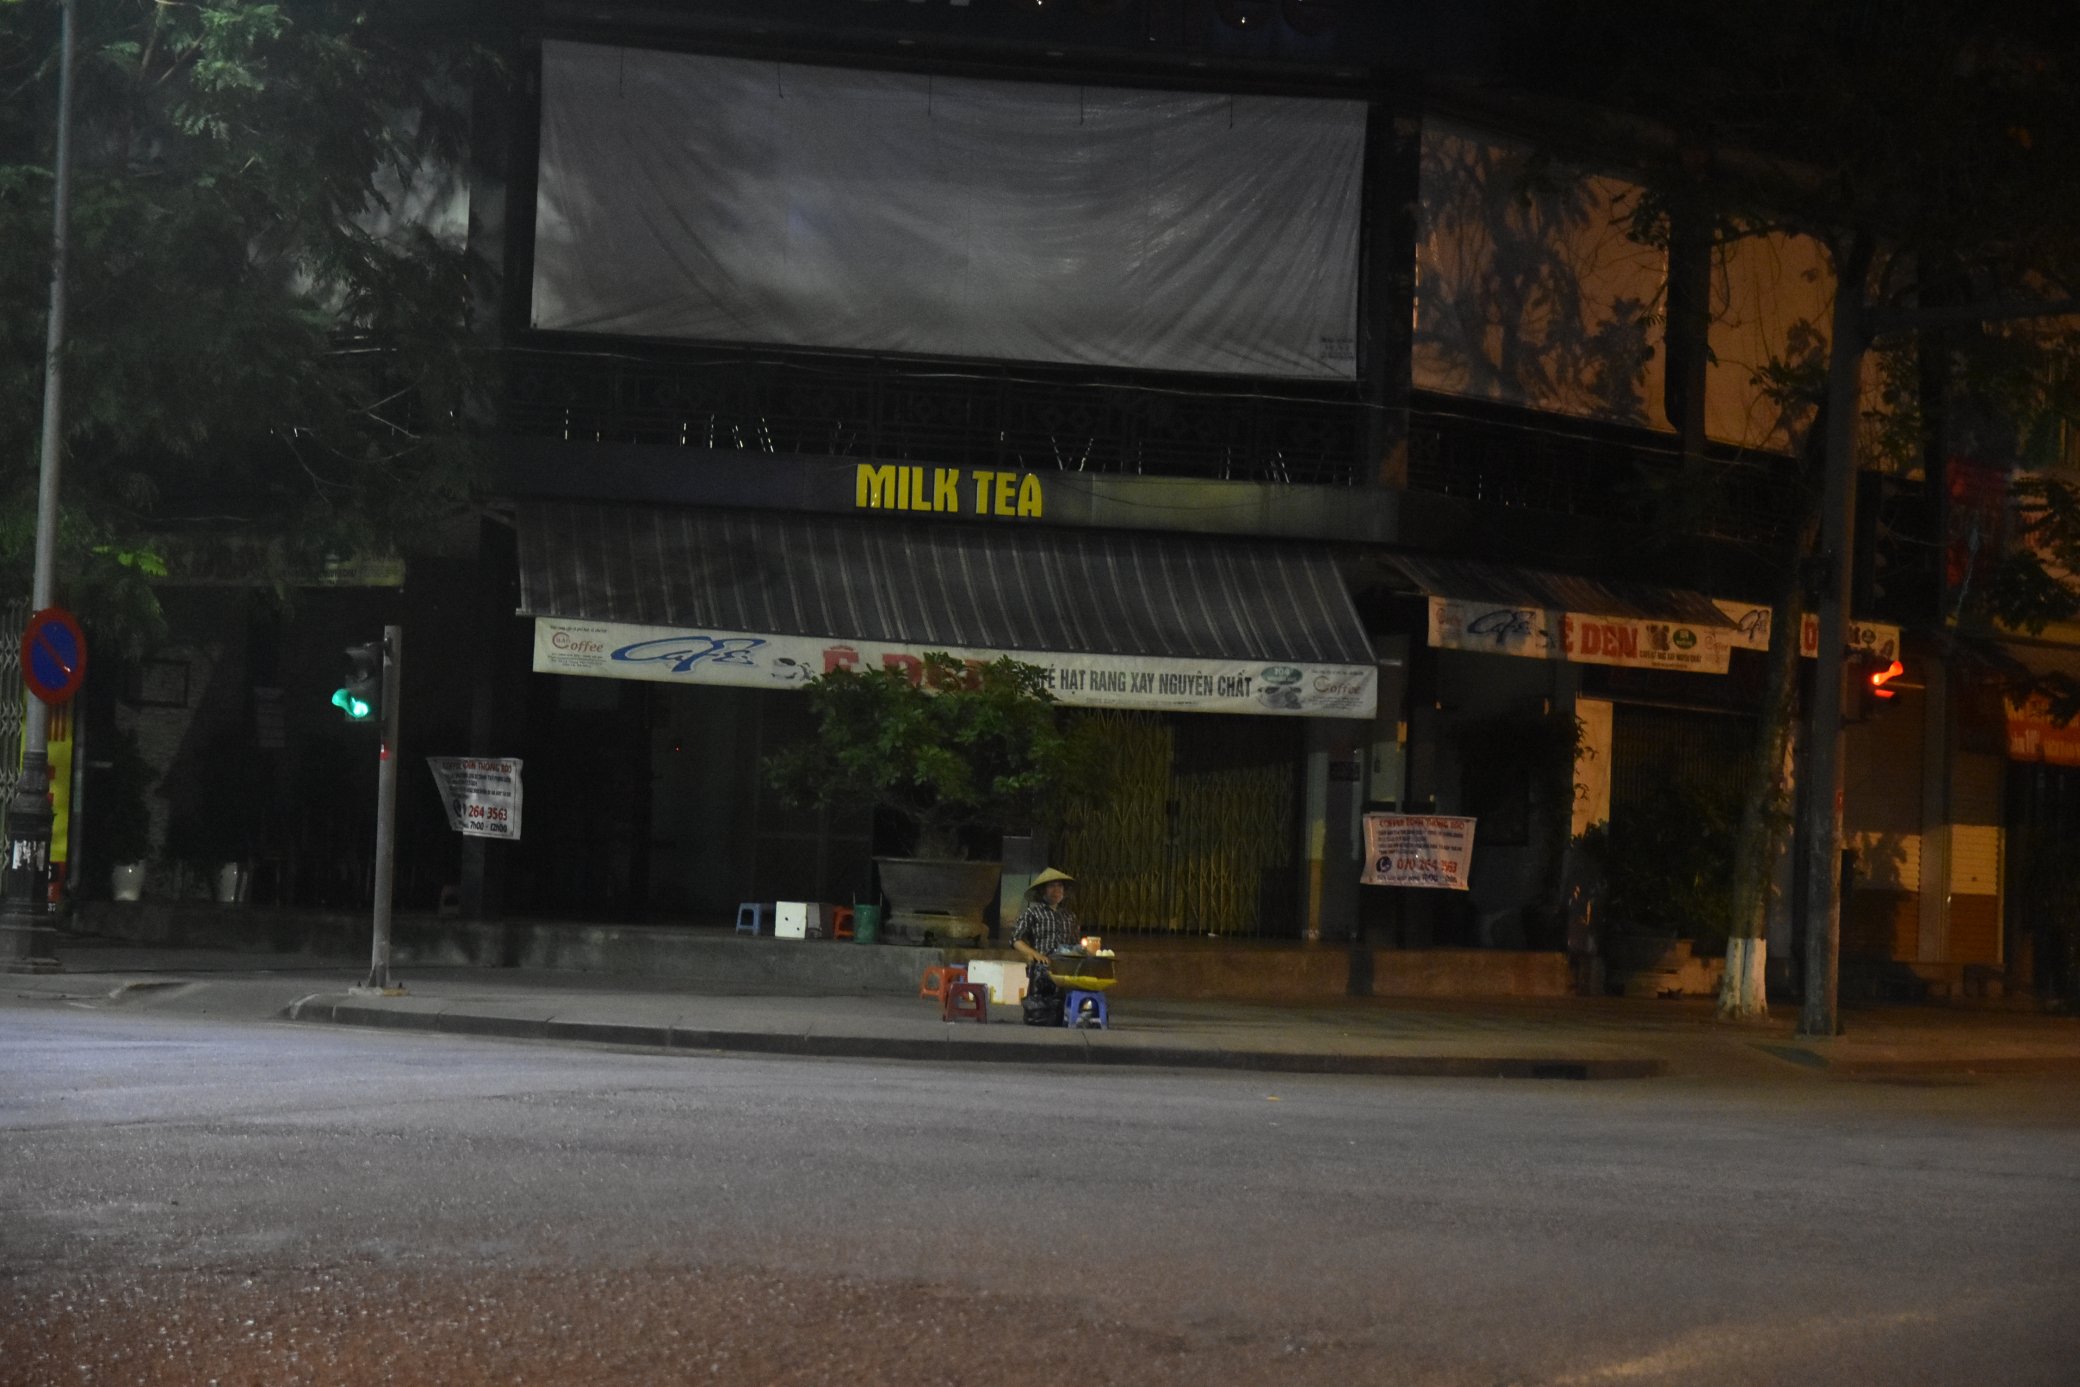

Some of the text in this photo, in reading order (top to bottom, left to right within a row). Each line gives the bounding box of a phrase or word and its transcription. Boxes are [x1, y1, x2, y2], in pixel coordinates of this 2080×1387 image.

[855, 463, 1043, 518] MILK TEA
[552, 632, 604, 653] Coffee
[1060, 669, 1085, 694] HẠT
[1090, 670, 1126, 692] RANG
[1130, 671, 1154, 694] XAY
[1159, 670, 1213, 696] NGUYÊN
[1217, 669, 1252, 697] CHẤT
